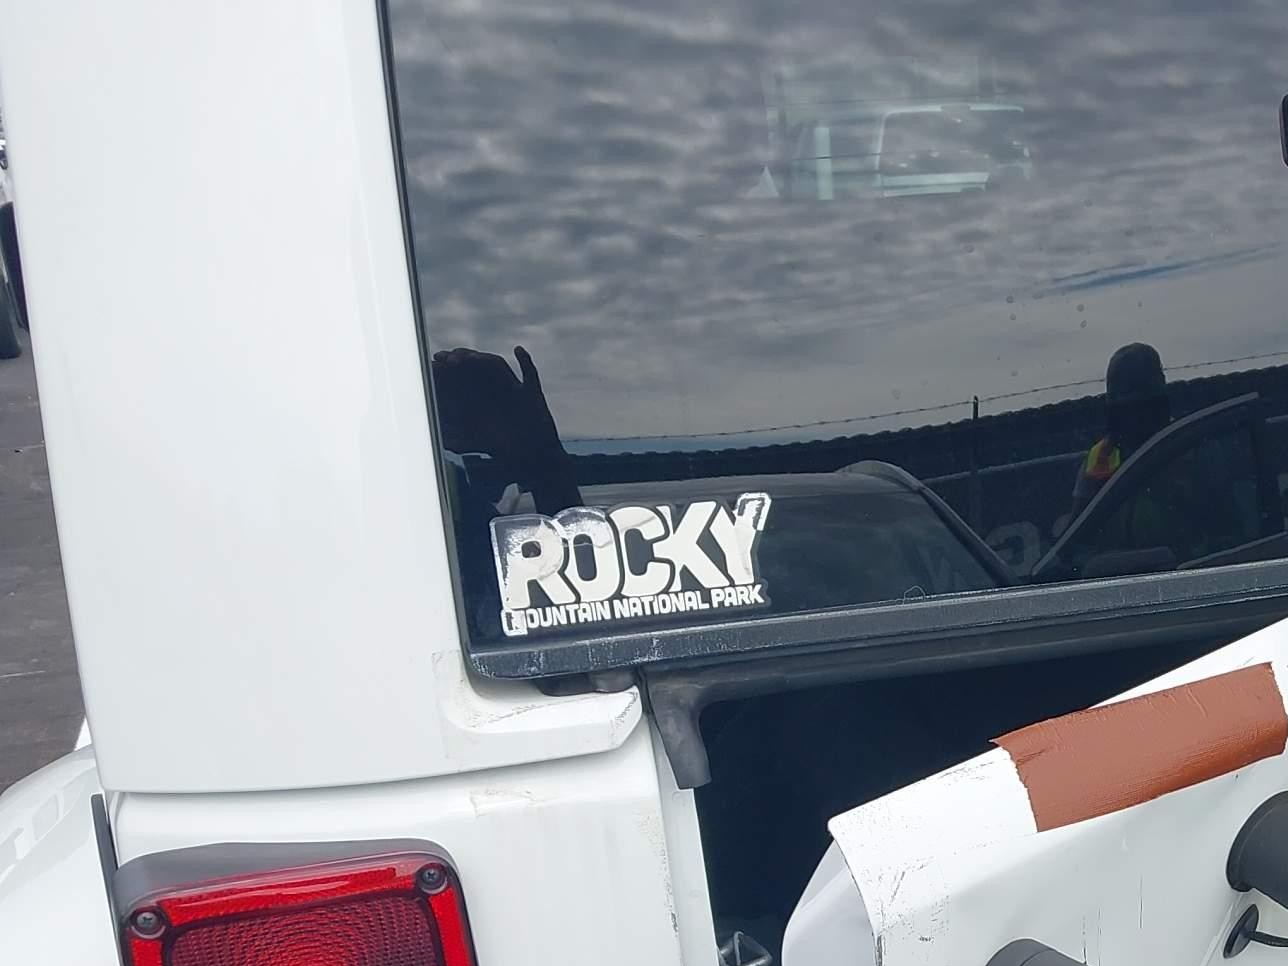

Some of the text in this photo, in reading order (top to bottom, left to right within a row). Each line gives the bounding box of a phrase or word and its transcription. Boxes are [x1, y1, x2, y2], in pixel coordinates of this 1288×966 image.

[489, 492, 772, 609] ROCKY
[613, 590, 710, 619] NATIONAL
[710, 584, 765, 608] PARK
